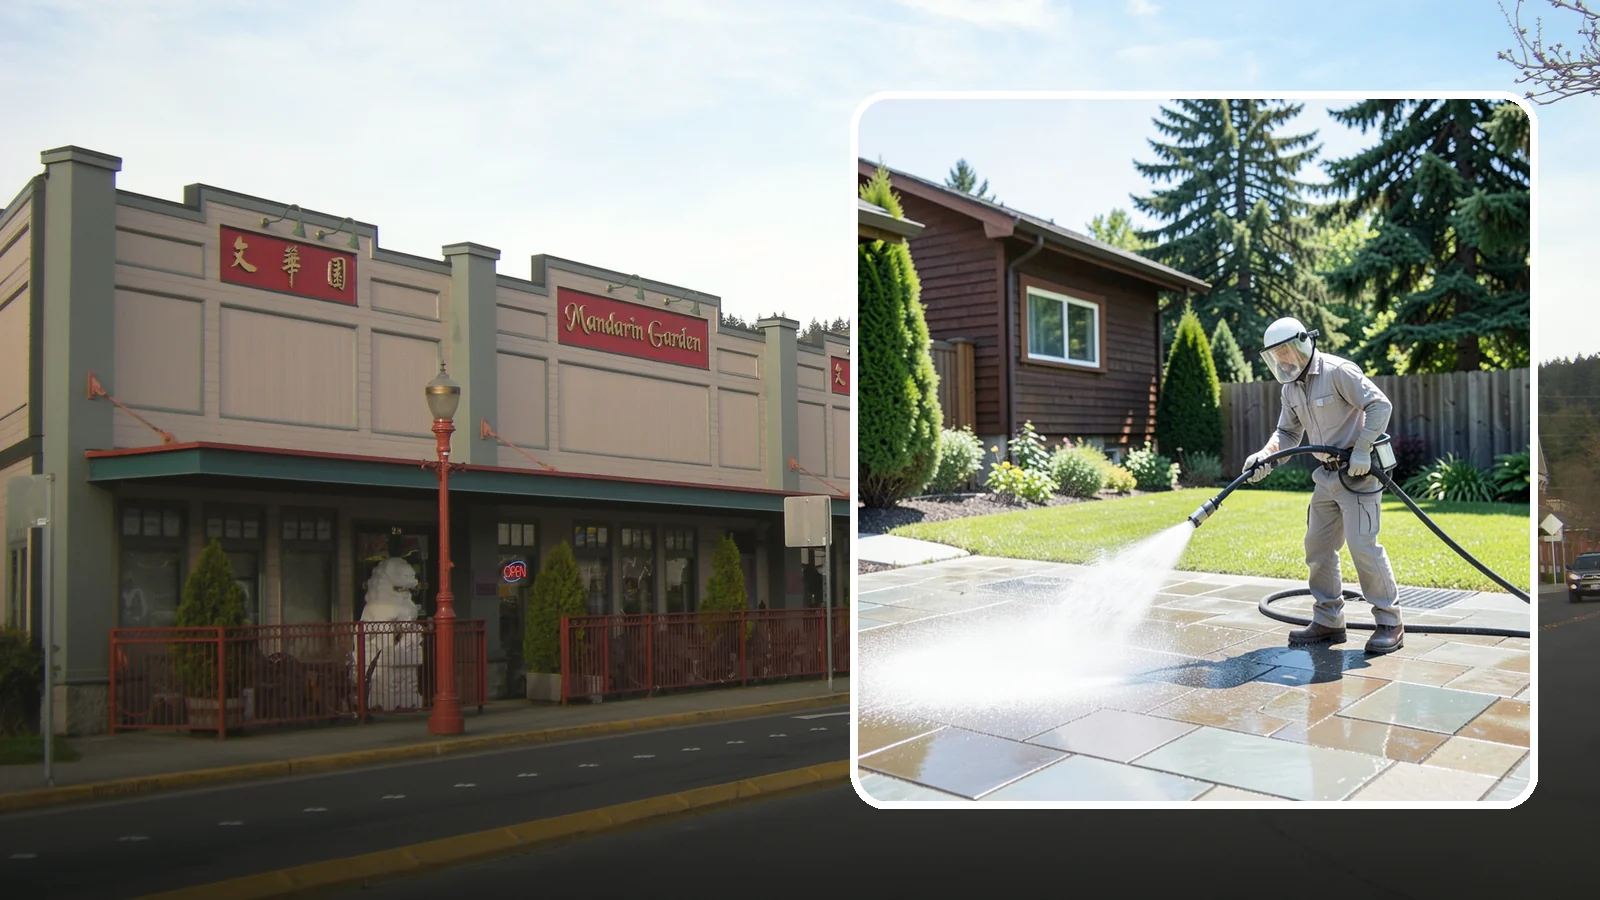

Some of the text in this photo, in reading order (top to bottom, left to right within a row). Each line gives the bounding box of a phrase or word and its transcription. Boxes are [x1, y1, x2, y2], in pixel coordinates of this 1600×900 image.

[231, 236, 346, 291] 文華園
[564, 302, 702, 352] Mandarin Garden
[503, 565, 527, 579] OPEN
